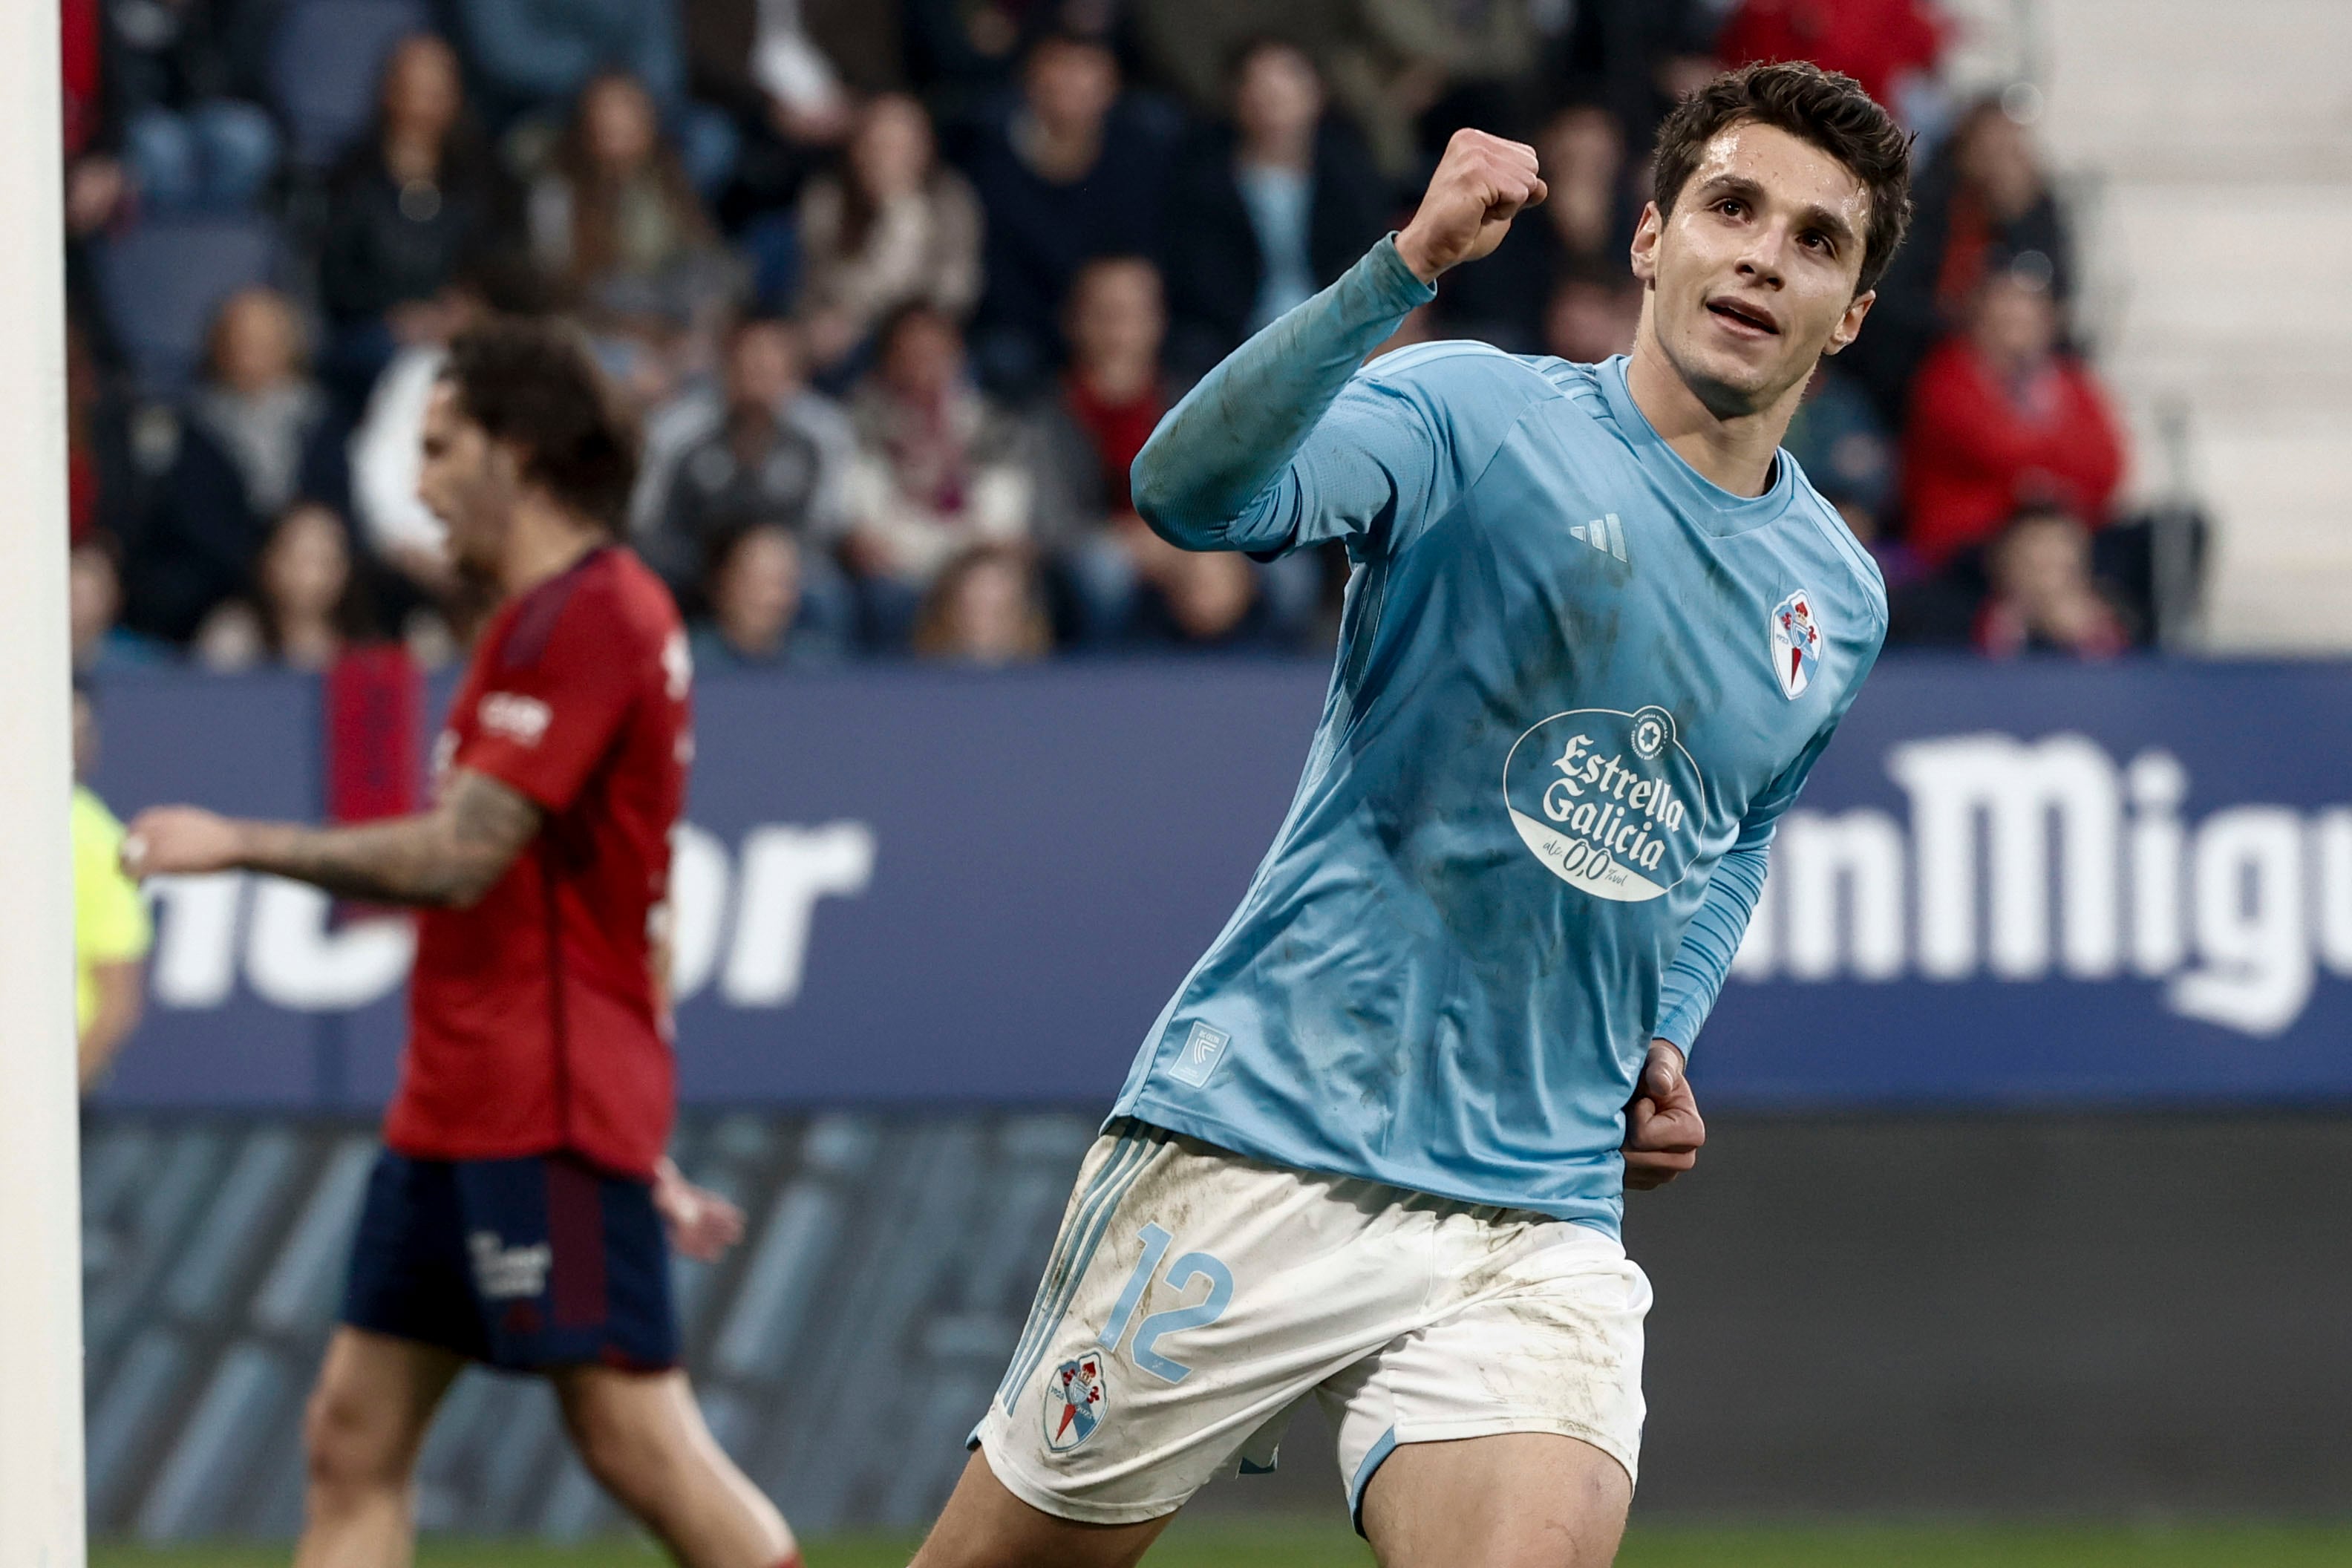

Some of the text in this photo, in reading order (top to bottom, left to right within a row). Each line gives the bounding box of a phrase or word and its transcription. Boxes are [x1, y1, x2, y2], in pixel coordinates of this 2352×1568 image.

[1543, 777, 1666, 871] Galicia
[1552, 734, 1685, 832] Estrella
[1563, 840, 1610, 881] 0,0
[1097, 1221, 1235, 1385] 12
